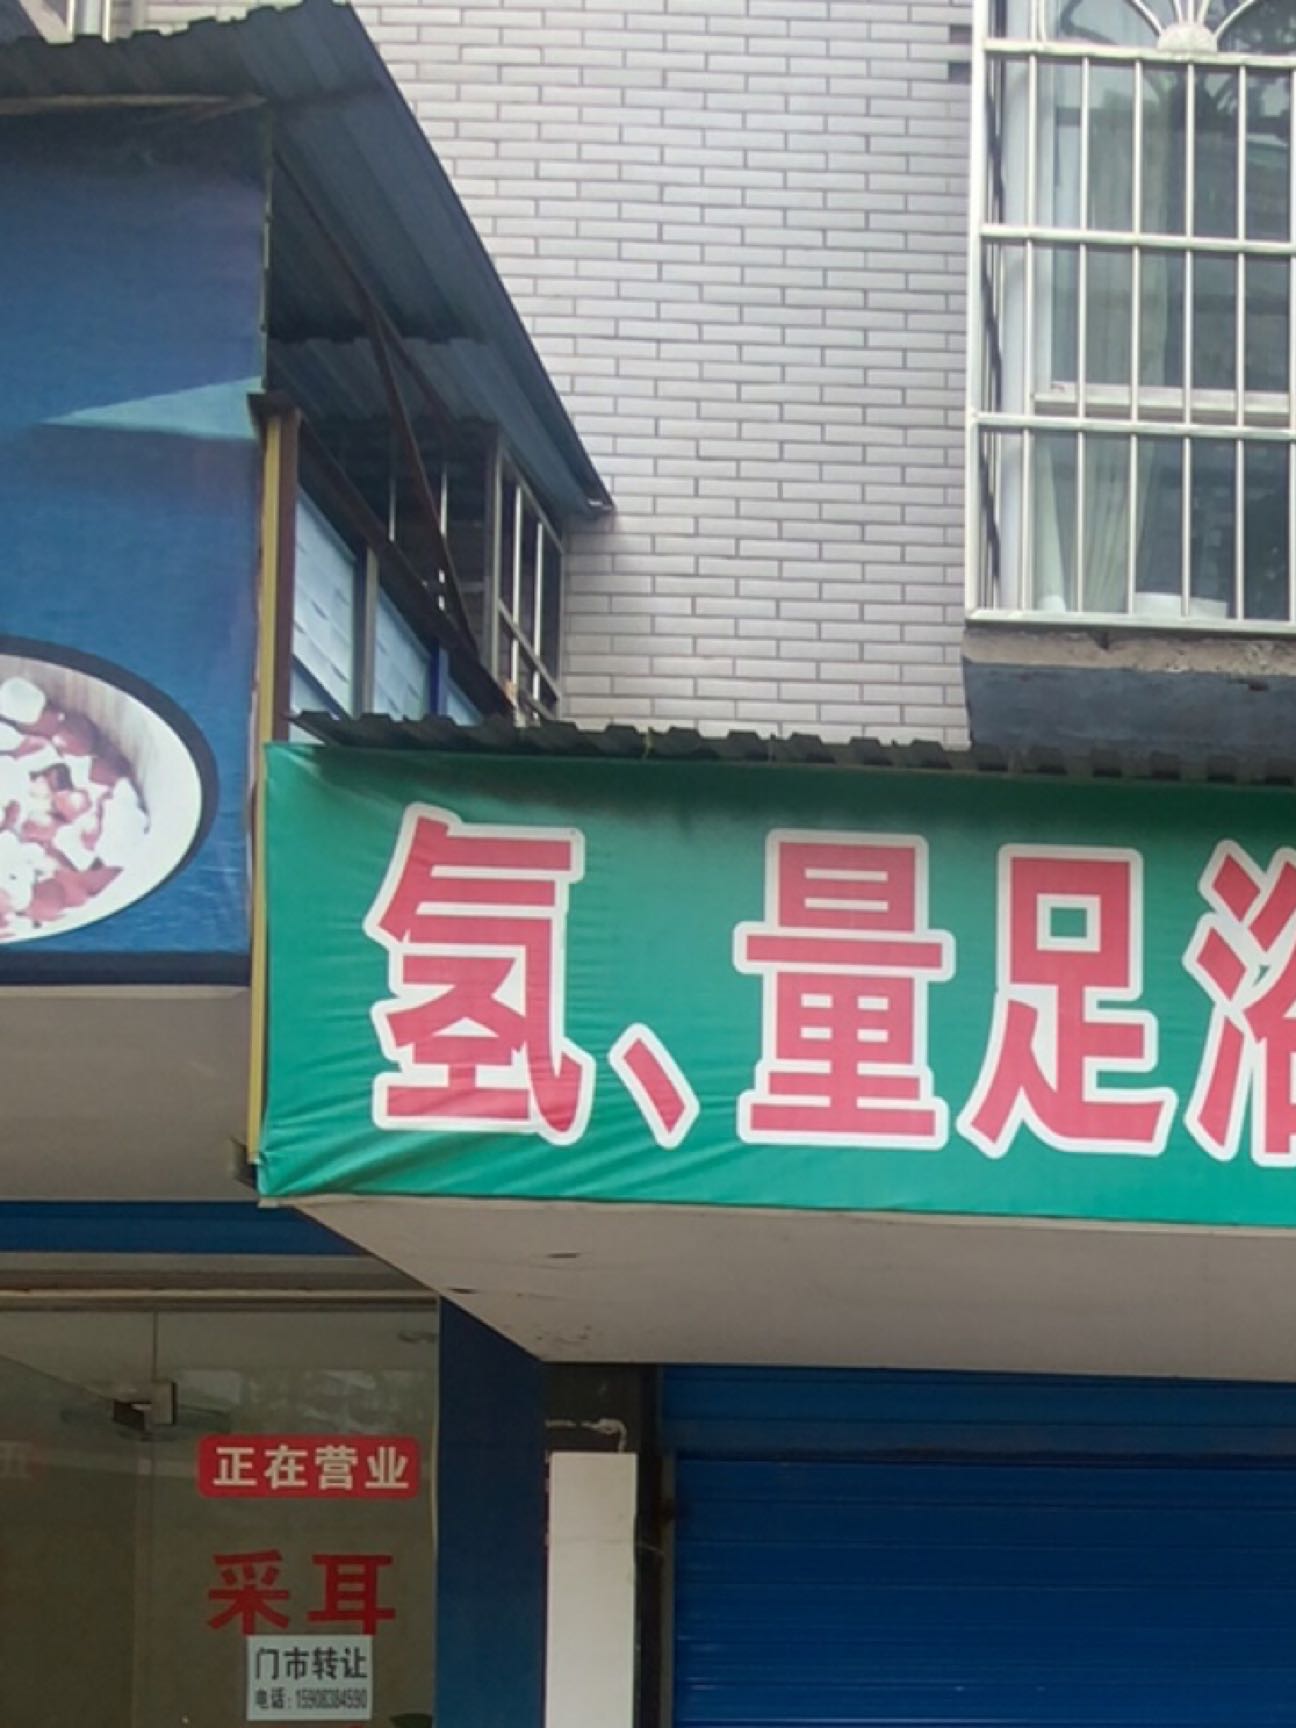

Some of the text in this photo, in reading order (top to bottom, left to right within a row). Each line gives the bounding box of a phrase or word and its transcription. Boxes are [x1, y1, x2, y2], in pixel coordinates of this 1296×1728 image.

[213, 1445, 409, 1490] 正在营业
[207, 1549, 397, 1636] 采耳
[256, 1646, 368, 1680] 门市转让
